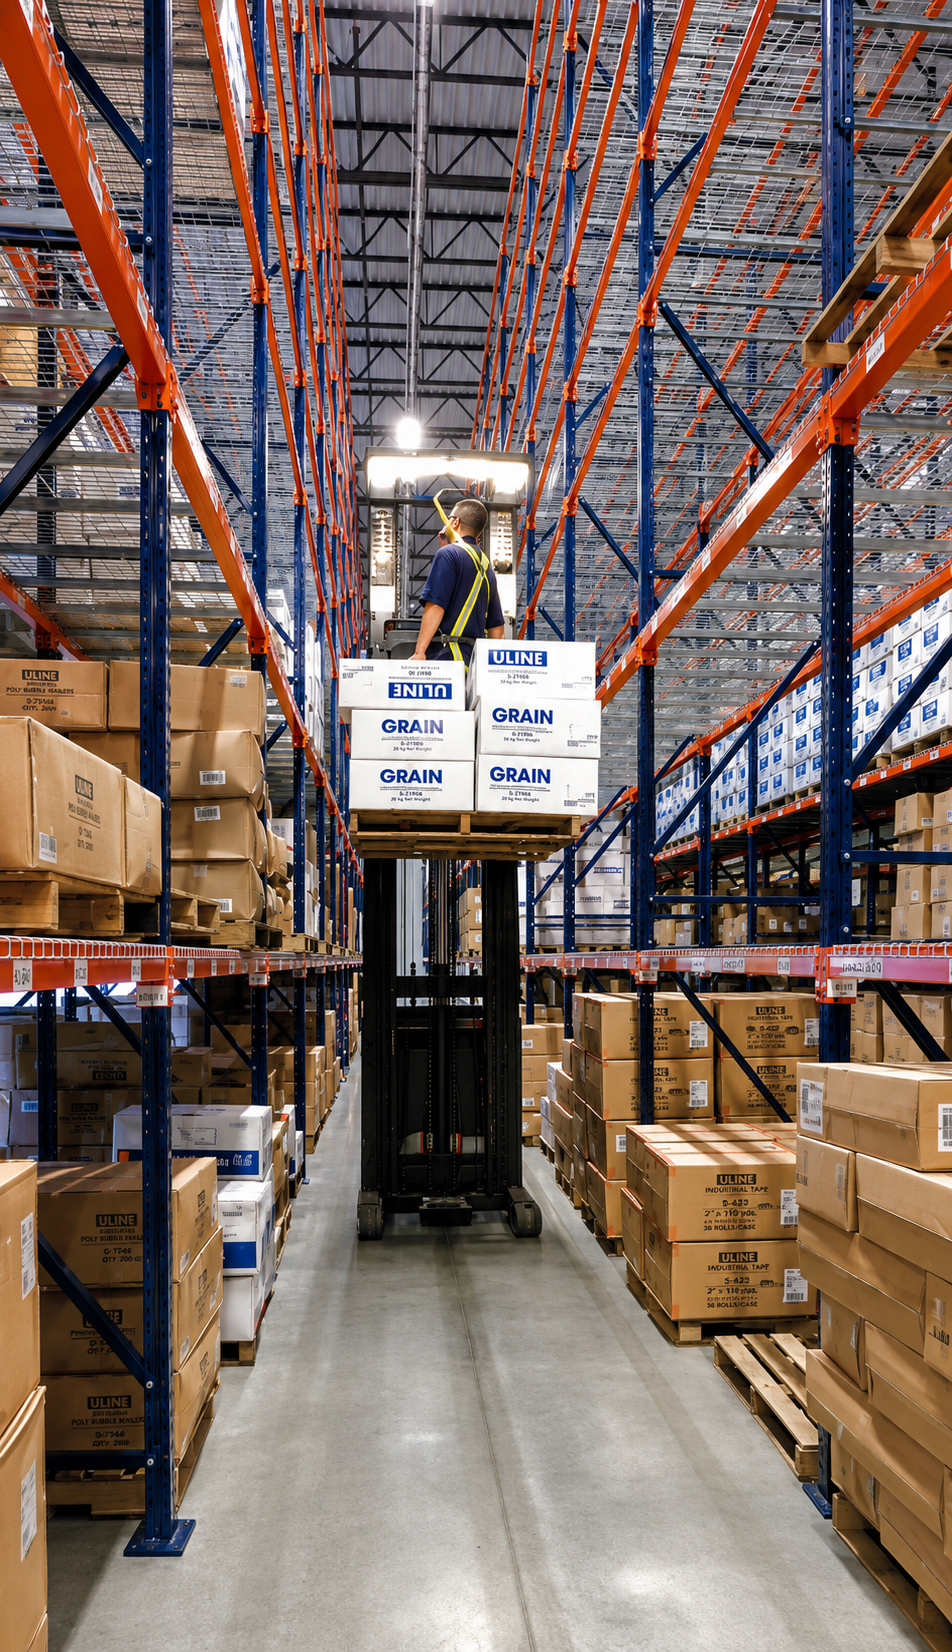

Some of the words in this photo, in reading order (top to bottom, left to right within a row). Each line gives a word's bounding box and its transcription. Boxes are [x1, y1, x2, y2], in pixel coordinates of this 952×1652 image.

[493, 651, 543, 665] ULINE
[24, 671, 57, 680] ULINE
[393, 684, 446, 698] ULINE
[492, 707, 553, 725] GRAIN
[381, 719, 443, 734] GRAIN
[380, 769, 442, 784] GRAIN
[490, 766, 551, 784] GRAIN
[720, 1175, 754, 1184] ULINE
[99, 1215, 135, 1226] ULINE
[722, 1253, 755, 1262] ULINE
[90, 1397, 128, 1408] ULINE
